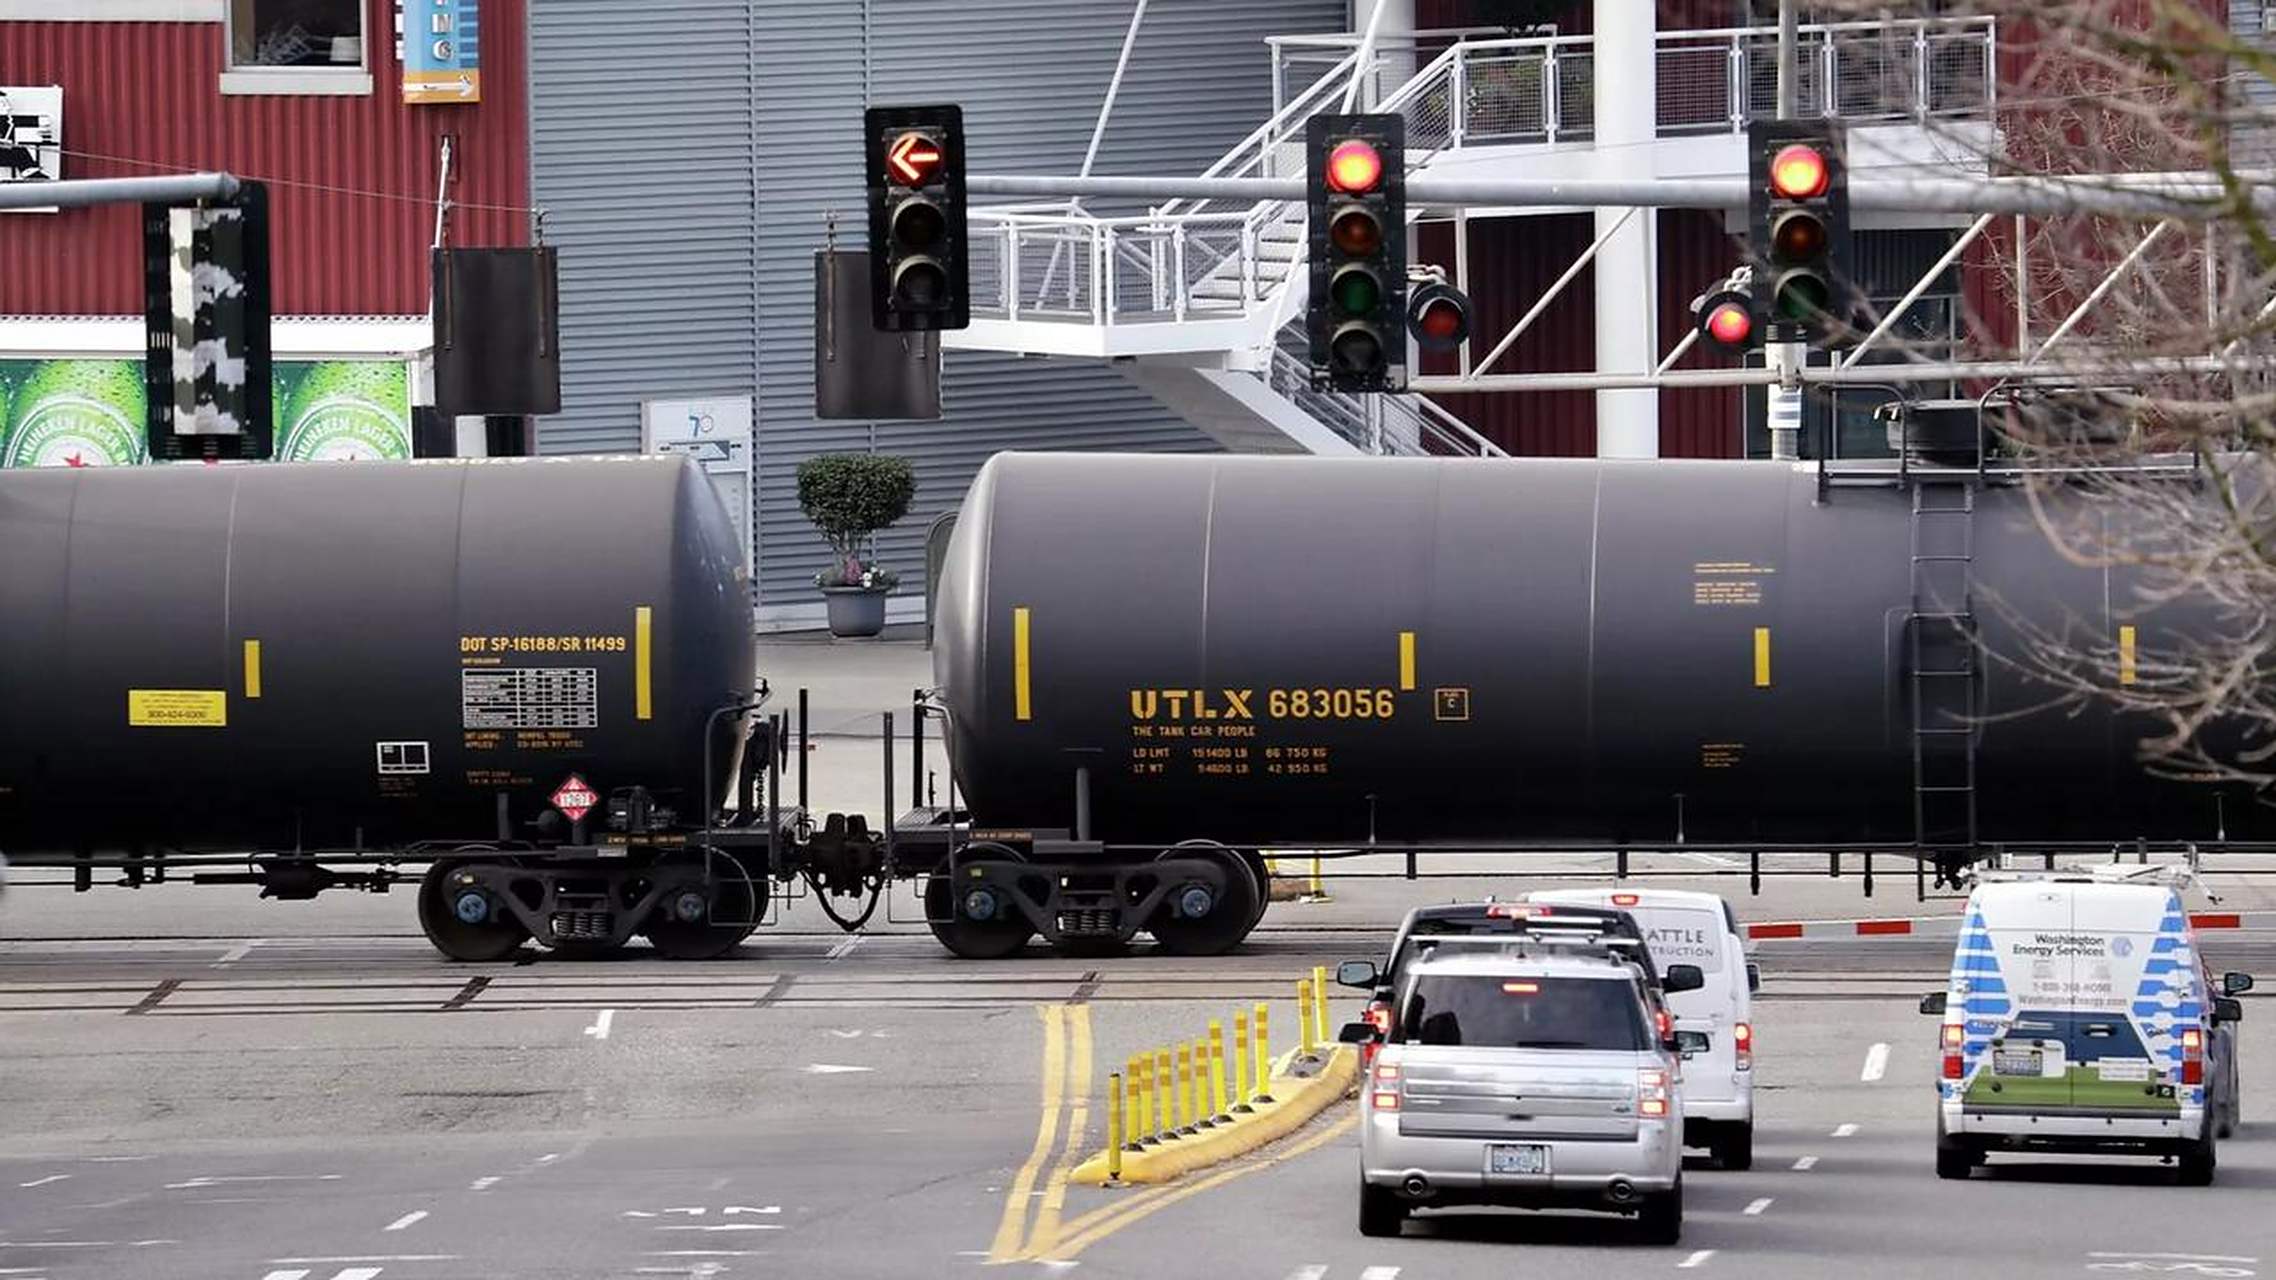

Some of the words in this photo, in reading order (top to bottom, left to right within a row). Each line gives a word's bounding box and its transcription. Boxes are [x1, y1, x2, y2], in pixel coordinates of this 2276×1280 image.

[431, 0, 453, 60] NG
[461, 637, 487, 651] DOT
[585, 637, 626, 650] 11499
[1131, 689, 1253, 719] UTLX
[1269, 689, 1395, 719] 683056
[1132, 726, 1153, 738] THE
[1159, 726, 1185, 738] TANK
[1190, 726, 1212, 738] CAR
[1217, 726, 1255, 738] PEOPLE
[1133, 747, 1147, 758] LD
[1149, 747, 1170, 758] LMT
[1235, 747, 1248, 758] LB
[1641, 928, 1704, 944] ATTLE
[2035, 934, 2105, 948] Washington
[1650, 945, 1713, 957] TRUCTION
[2013, 943, 2053, 956] Energy
[2056, 944, 2105, 956] Services
